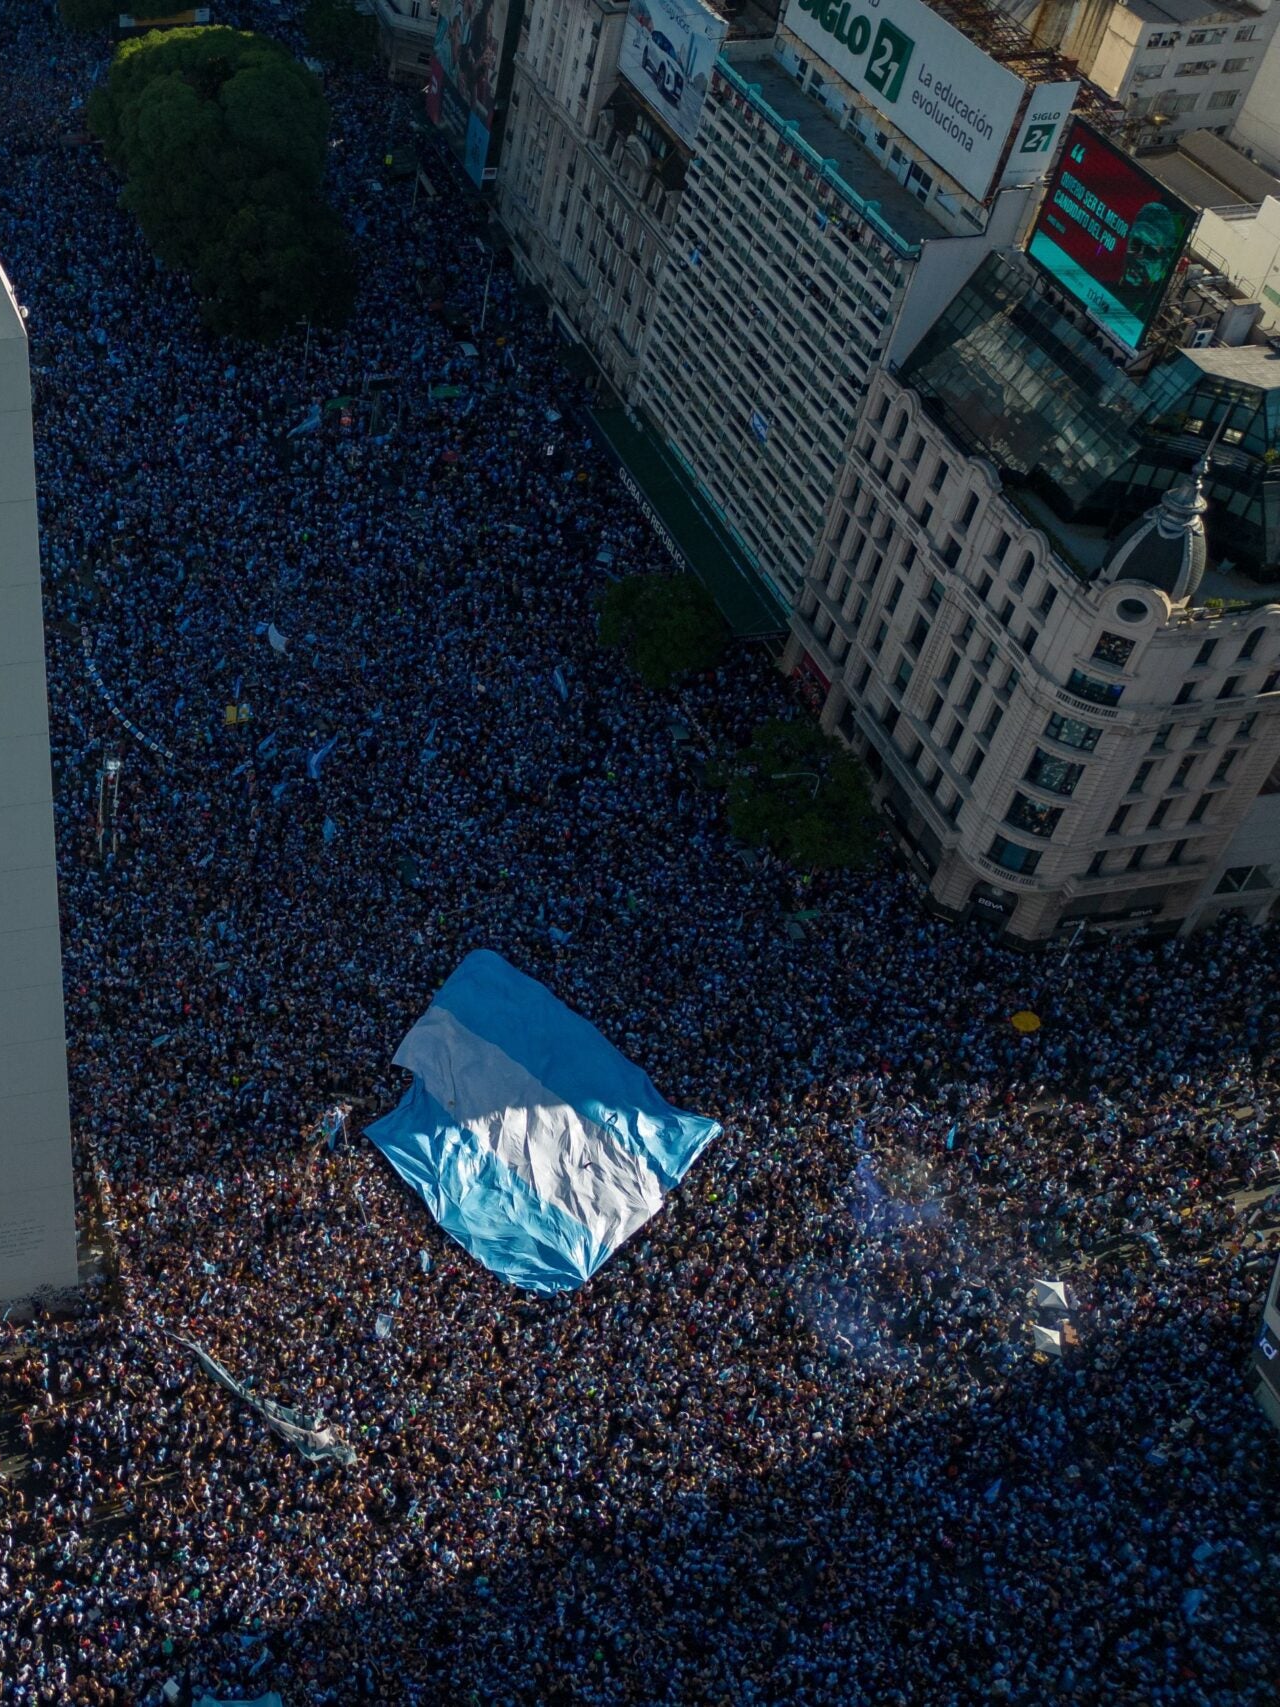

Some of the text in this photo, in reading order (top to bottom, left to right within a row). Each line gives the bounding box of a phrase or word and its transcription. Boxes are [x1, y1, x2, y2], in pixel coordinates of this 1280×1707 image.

[798, 0, 900, 98] IGLO 21
[911, 90, 974, 152] evoluciona
[918, 63, 993, 141] La educación
[1031, 111, 1061, 121] SIGLO
[1024, 130, 1049, 152] 21
[1053, 189, 1090, 229] CANDIDATO
[1087, 219, 1101, 240] DEL
[1100, 230, 1117, 251] PRO
[1061, 171, 1128, 238] QUIERO SER EL MEJOR
[978, 897, 1004, 912] BBVA
